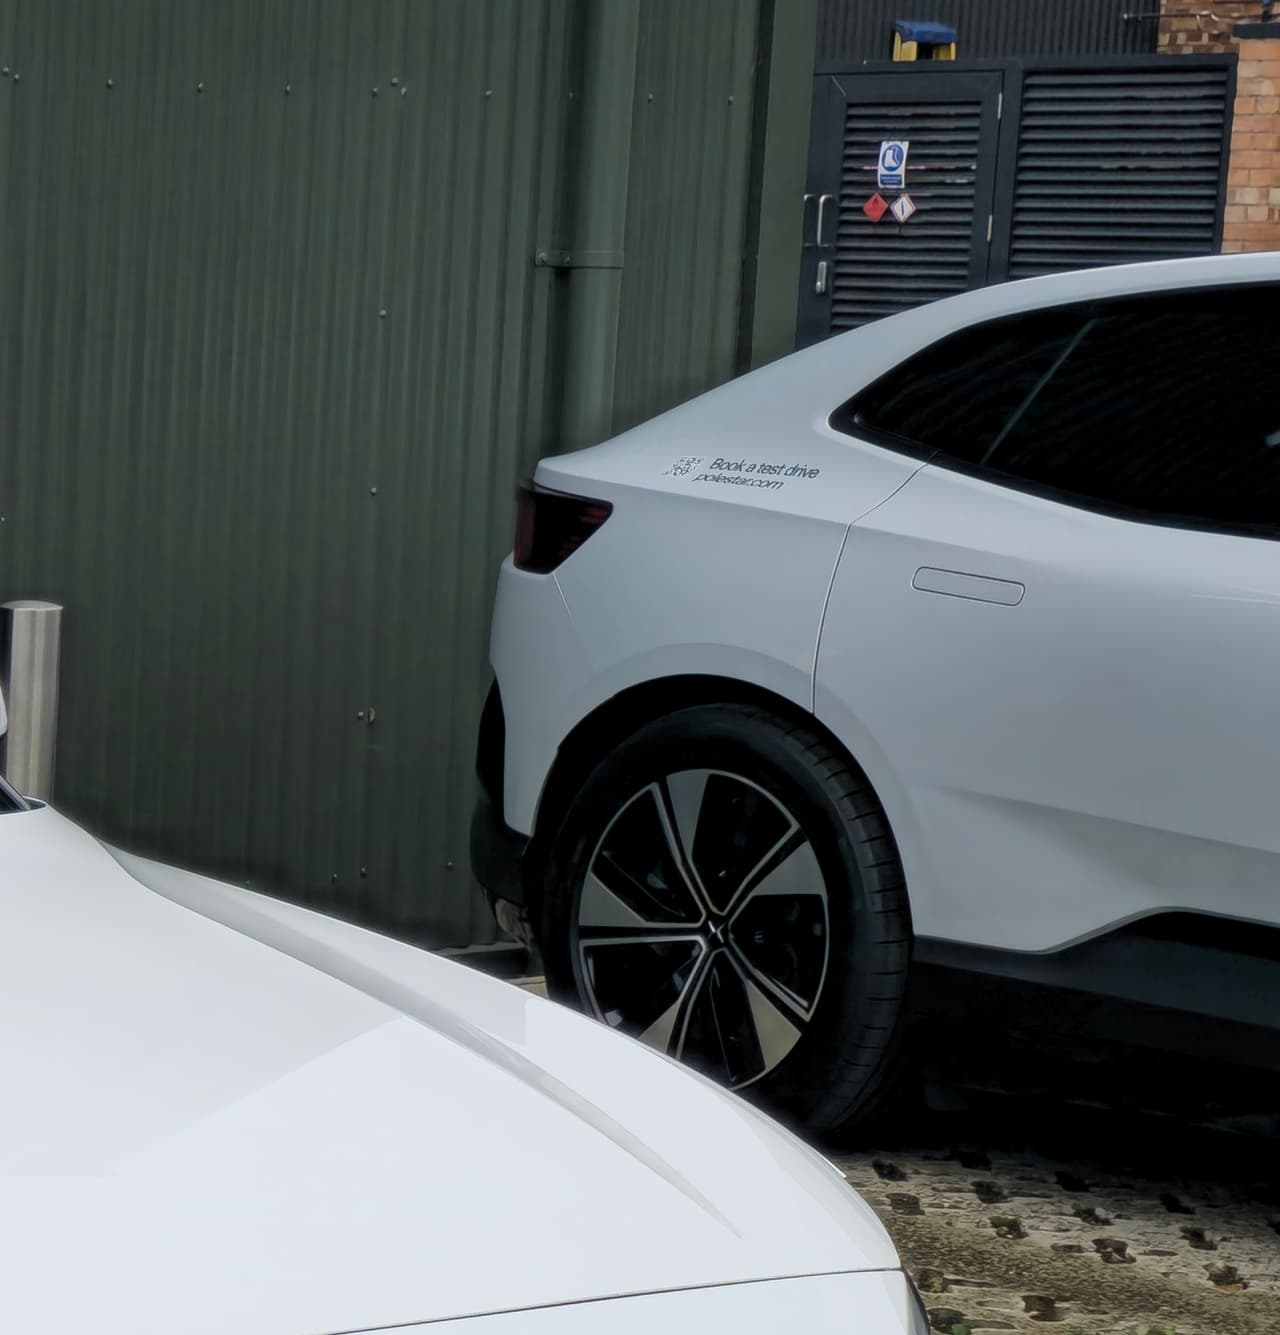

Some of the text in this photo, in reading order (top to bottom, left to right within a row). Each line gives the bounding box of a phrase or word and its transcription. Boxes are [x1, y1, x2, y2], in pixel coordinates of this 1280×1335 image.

[709, 457, 820, 479] Book a test drive
[692, 474, 784, 490] polestar.com
